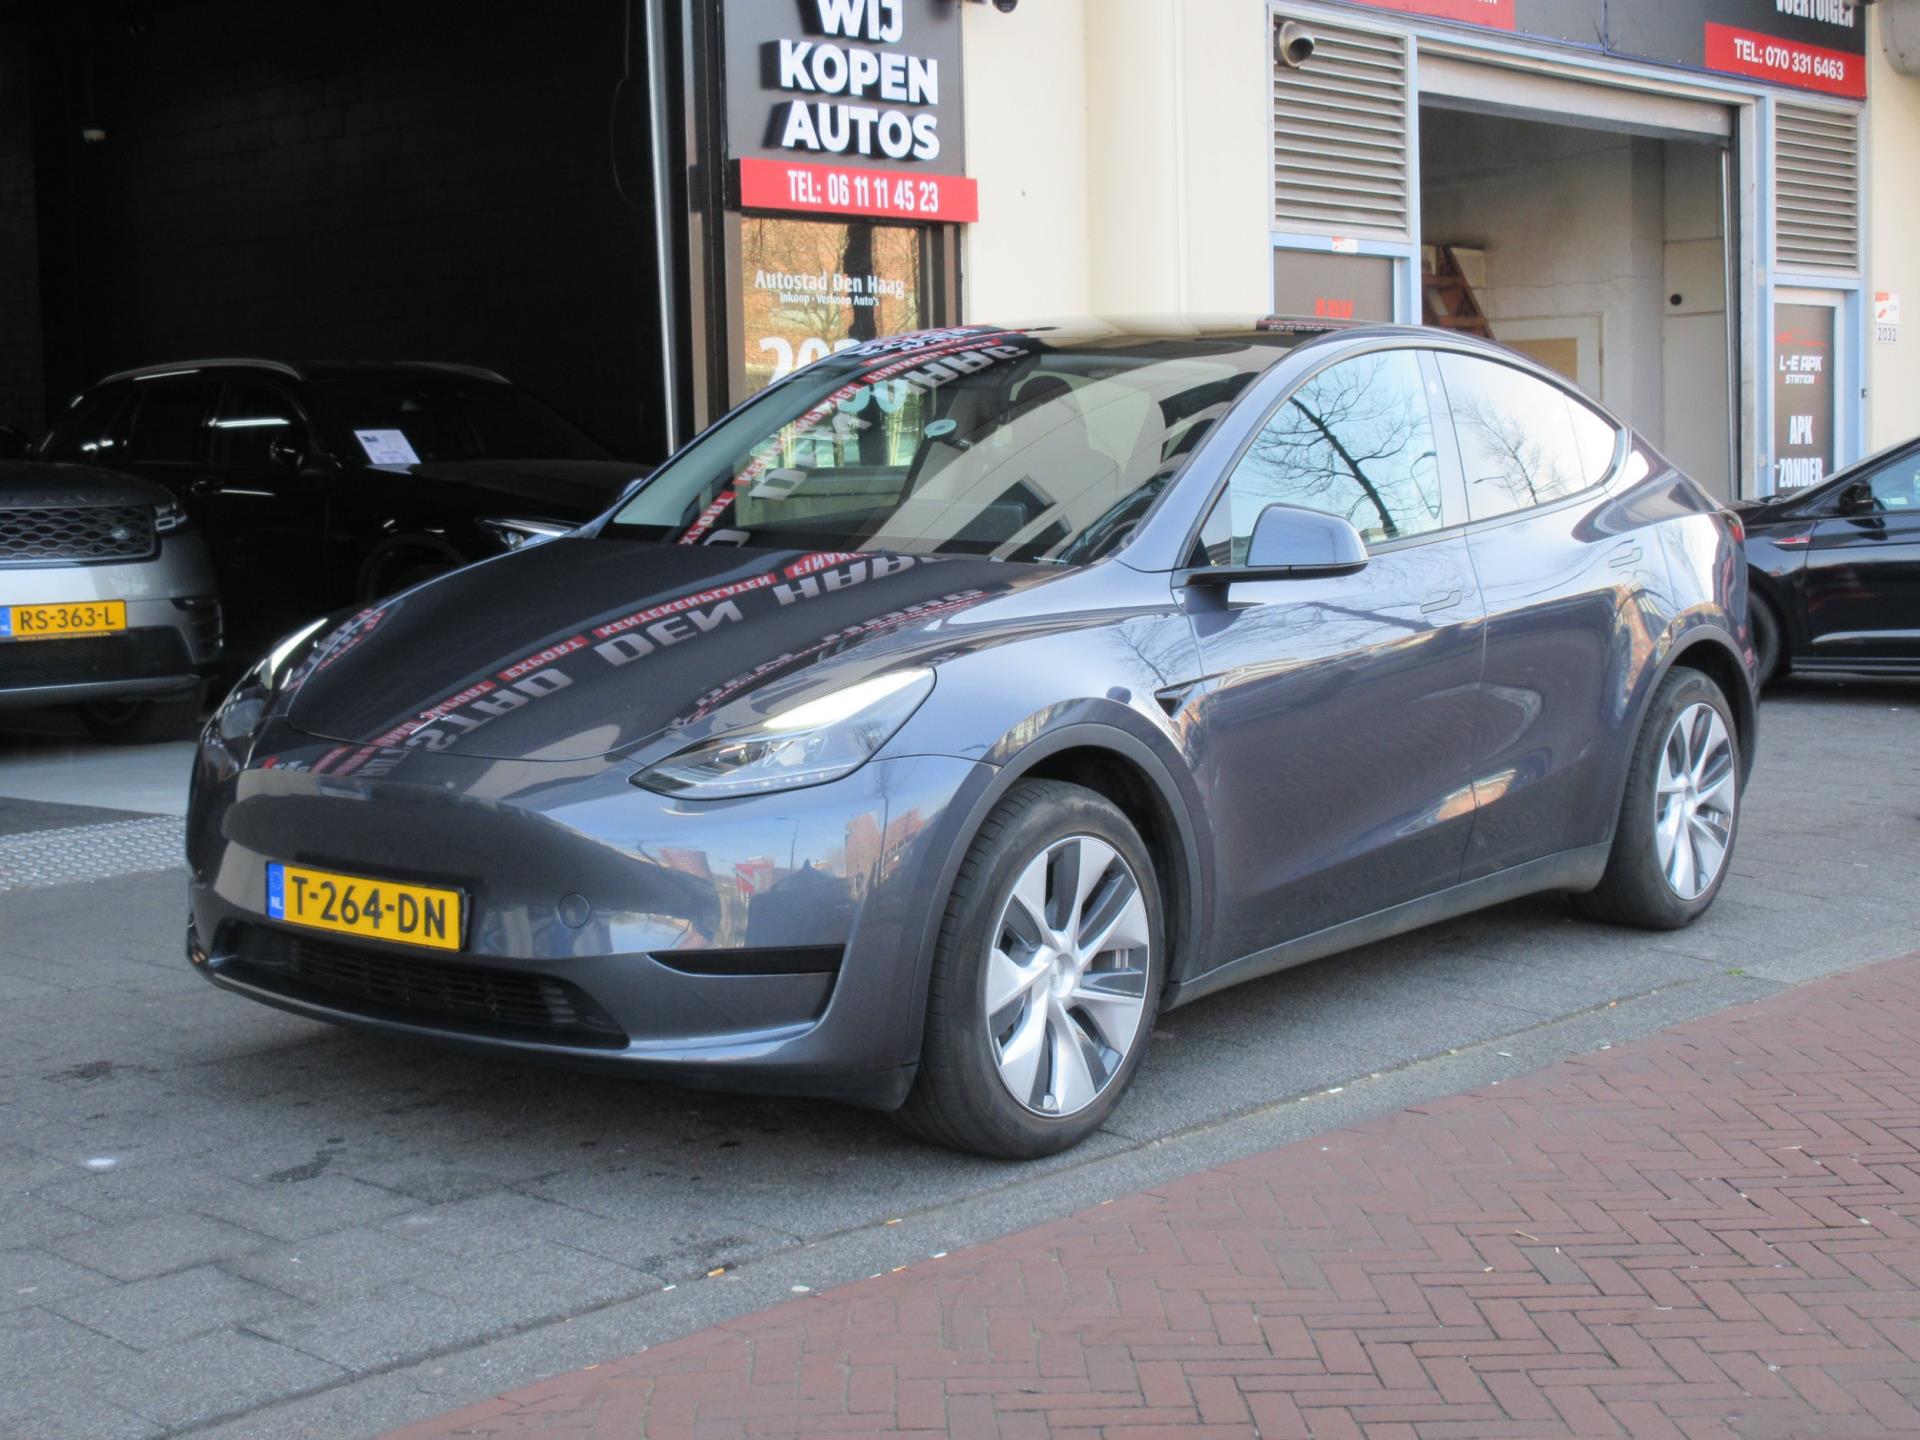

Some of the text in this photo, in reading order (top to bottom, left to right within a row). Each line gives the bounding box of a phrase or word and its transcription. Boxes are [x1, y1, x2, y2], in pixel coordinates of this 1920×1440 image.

[816, 0, 903, 43] WIJ
[779, 39, 939, 105] KOPEN
[1734, 38, 1844, 81] TEL: 070 331 6463
[782, 100, 940, 160] AUTOS
[787, 170, 939, 213] TEL: 06 11 11 45 23
[755, 270, 905, 299] Autostad Den Haag
[780, 292, 810, 304] Inkoop
[816, 294, 851, 306] Verkoop
[853, 296, 880, 307] Auto's
[1800, 356, 1822, 372] APK
[1785, 375, 1814, 384] STATION
[1789, 416, 1813, 444] APK
[1779, 458, 1823, 488] ZONDER
[20, 607, 115, 631] RS-363-L
[271, 875, 446, 940] NL T-264-DN
